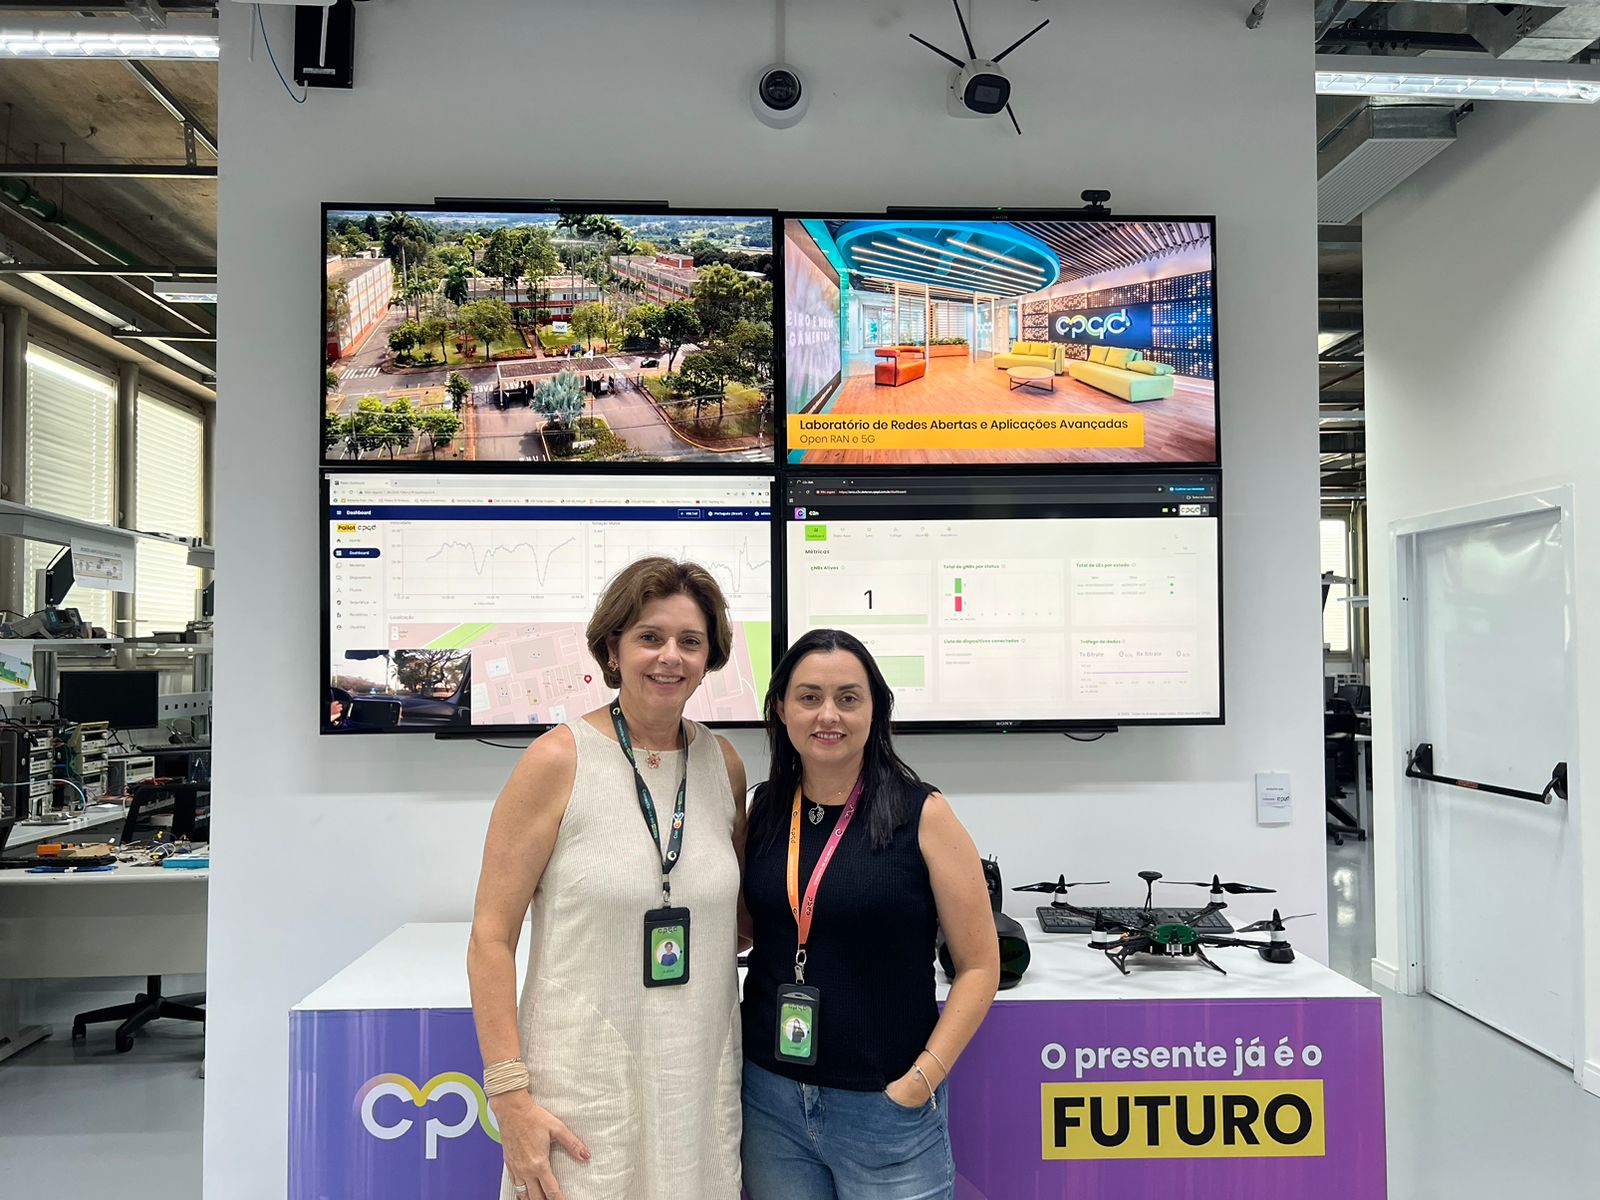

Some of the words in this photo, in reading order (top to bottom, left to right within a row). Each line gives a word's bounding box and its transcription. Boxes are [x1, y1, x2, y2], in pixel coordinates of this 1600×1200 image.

[1056, 309, 1132, 339] cpqd
[800, 419, 870, 430] Laboratório
[873, 419, 888, 430] de
[891, 419, 927, 430] Redes
[930, 419, 977, 430] Abertas
[990, 419, 1057, 431] Aplicações
[1059, 418, 1128, 430] Avançadas
[800, 434, 828, 445] Open
[830, 434, 850, 444] RAN
[861, 434, 875, 444] 5G
[864, 589, 873, 610] 1
[1041, 1042, 1067, 1070] O
[1075, 1041, 1227, 1078] presente
[1233, 1037, 1266, 1076] já
[1273, 1036, 1294, 1067] é
[1301, 1044, 1322, 1066] o
[353, 1072, 503, 1159] cp
[1054, 1093, 1313, 1147] FUTURO
